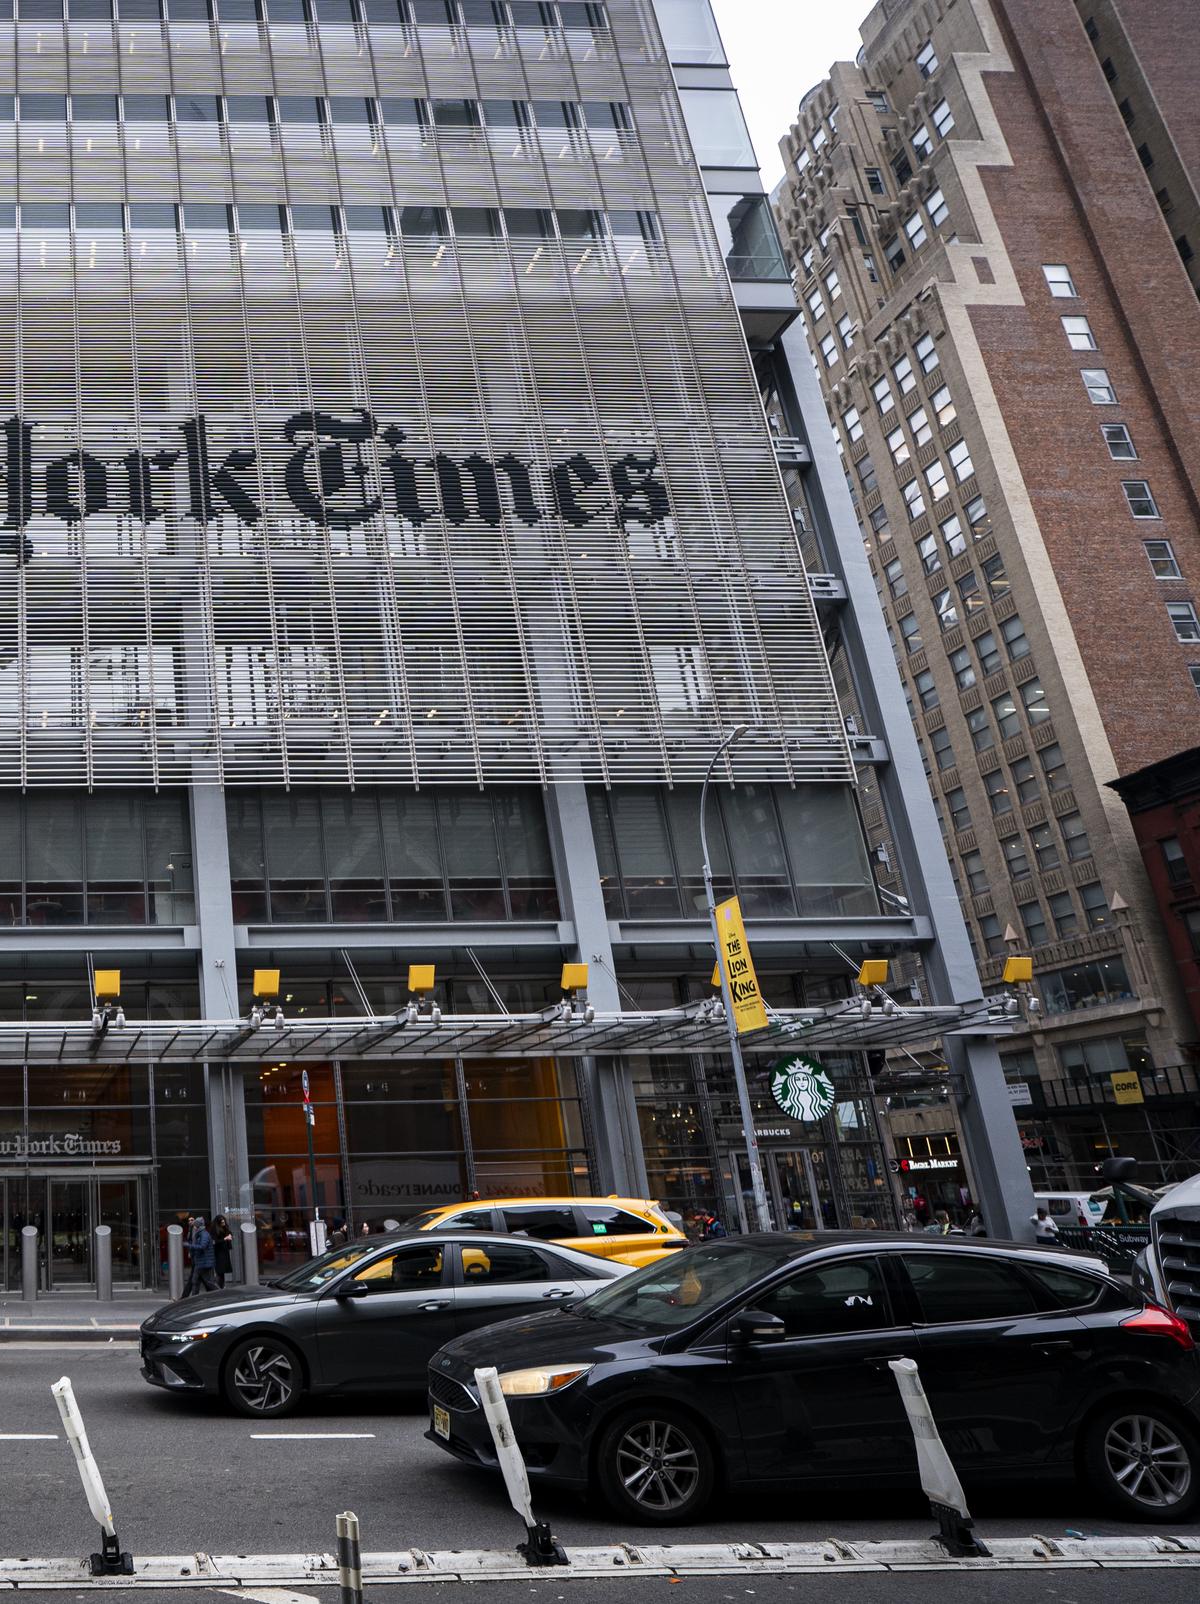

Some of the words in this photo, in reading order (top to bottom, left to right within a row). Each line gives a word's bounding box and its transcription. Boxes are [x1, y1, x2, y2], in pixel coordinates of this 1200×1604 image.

[284, 407, 672, 533] Times
[726, 939, 741, 953] THE
[727, 959, 748, 979] LION
[730, 980, 757, 1003] KING
[10, 1134, 62, 1160] York
[64, 1133, 122, 1155] Times
[1119, 1234, 1148, 1244] Subway
